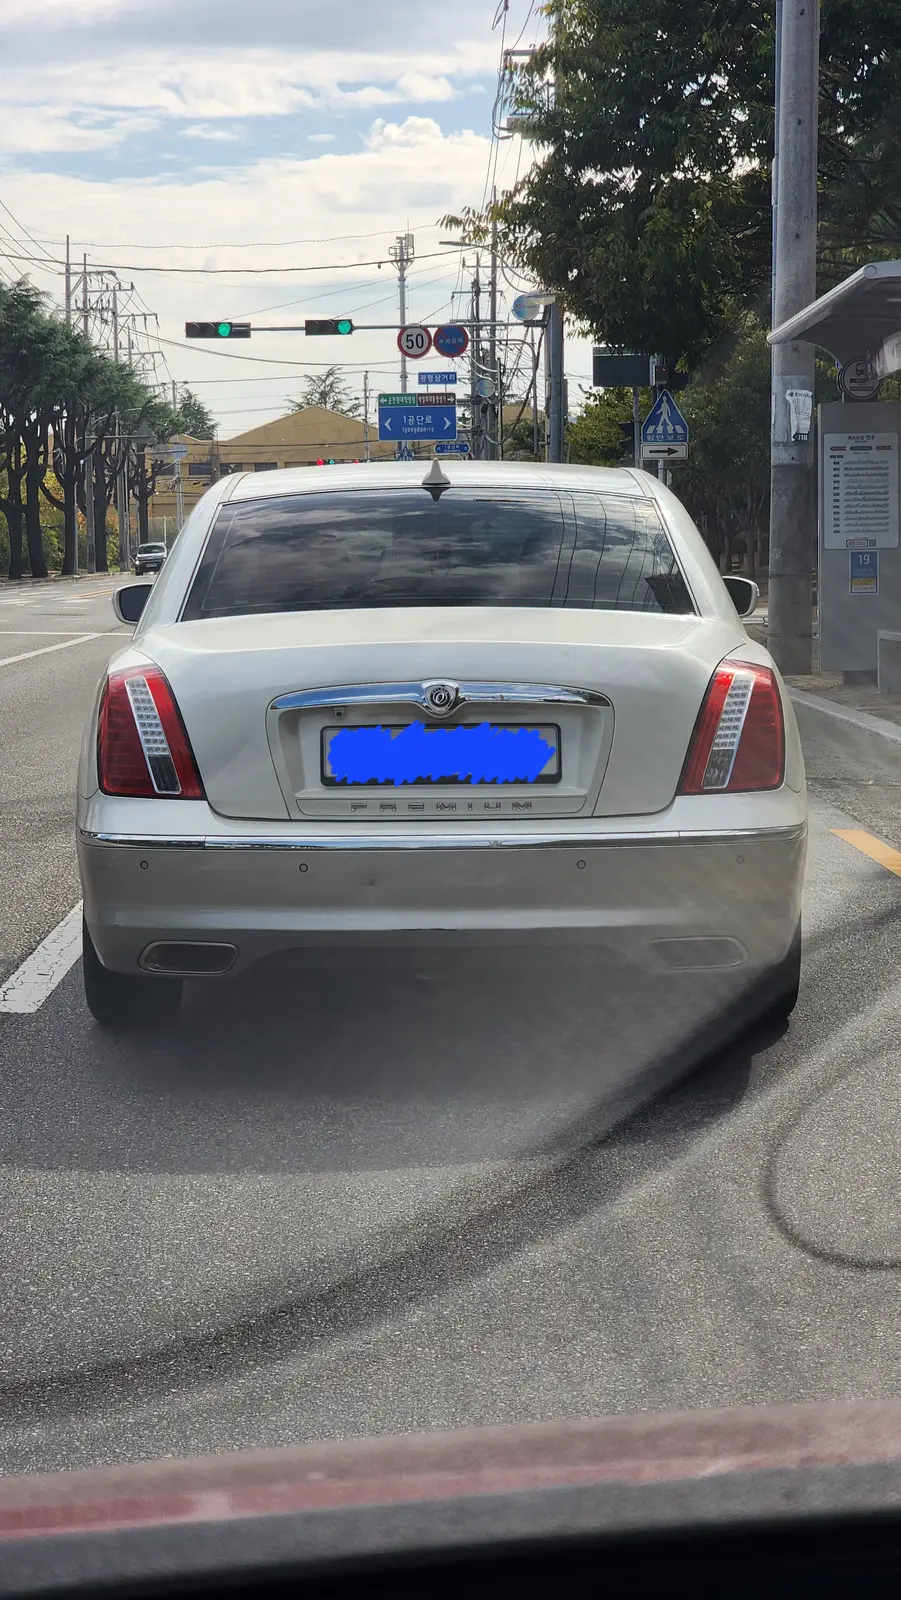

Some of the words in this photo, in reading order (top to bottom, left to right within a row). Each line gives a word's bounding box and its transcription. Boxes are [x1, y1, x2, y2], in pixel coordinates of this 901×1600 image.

[406, 333, 424, 350] 50
[420, 374, 456, 382] 광평삼거리
[403, 415, 433, 426] 1공단로
[857, 554, 870, 565] 19
[351, 802, 532, 812] PREMIUM
